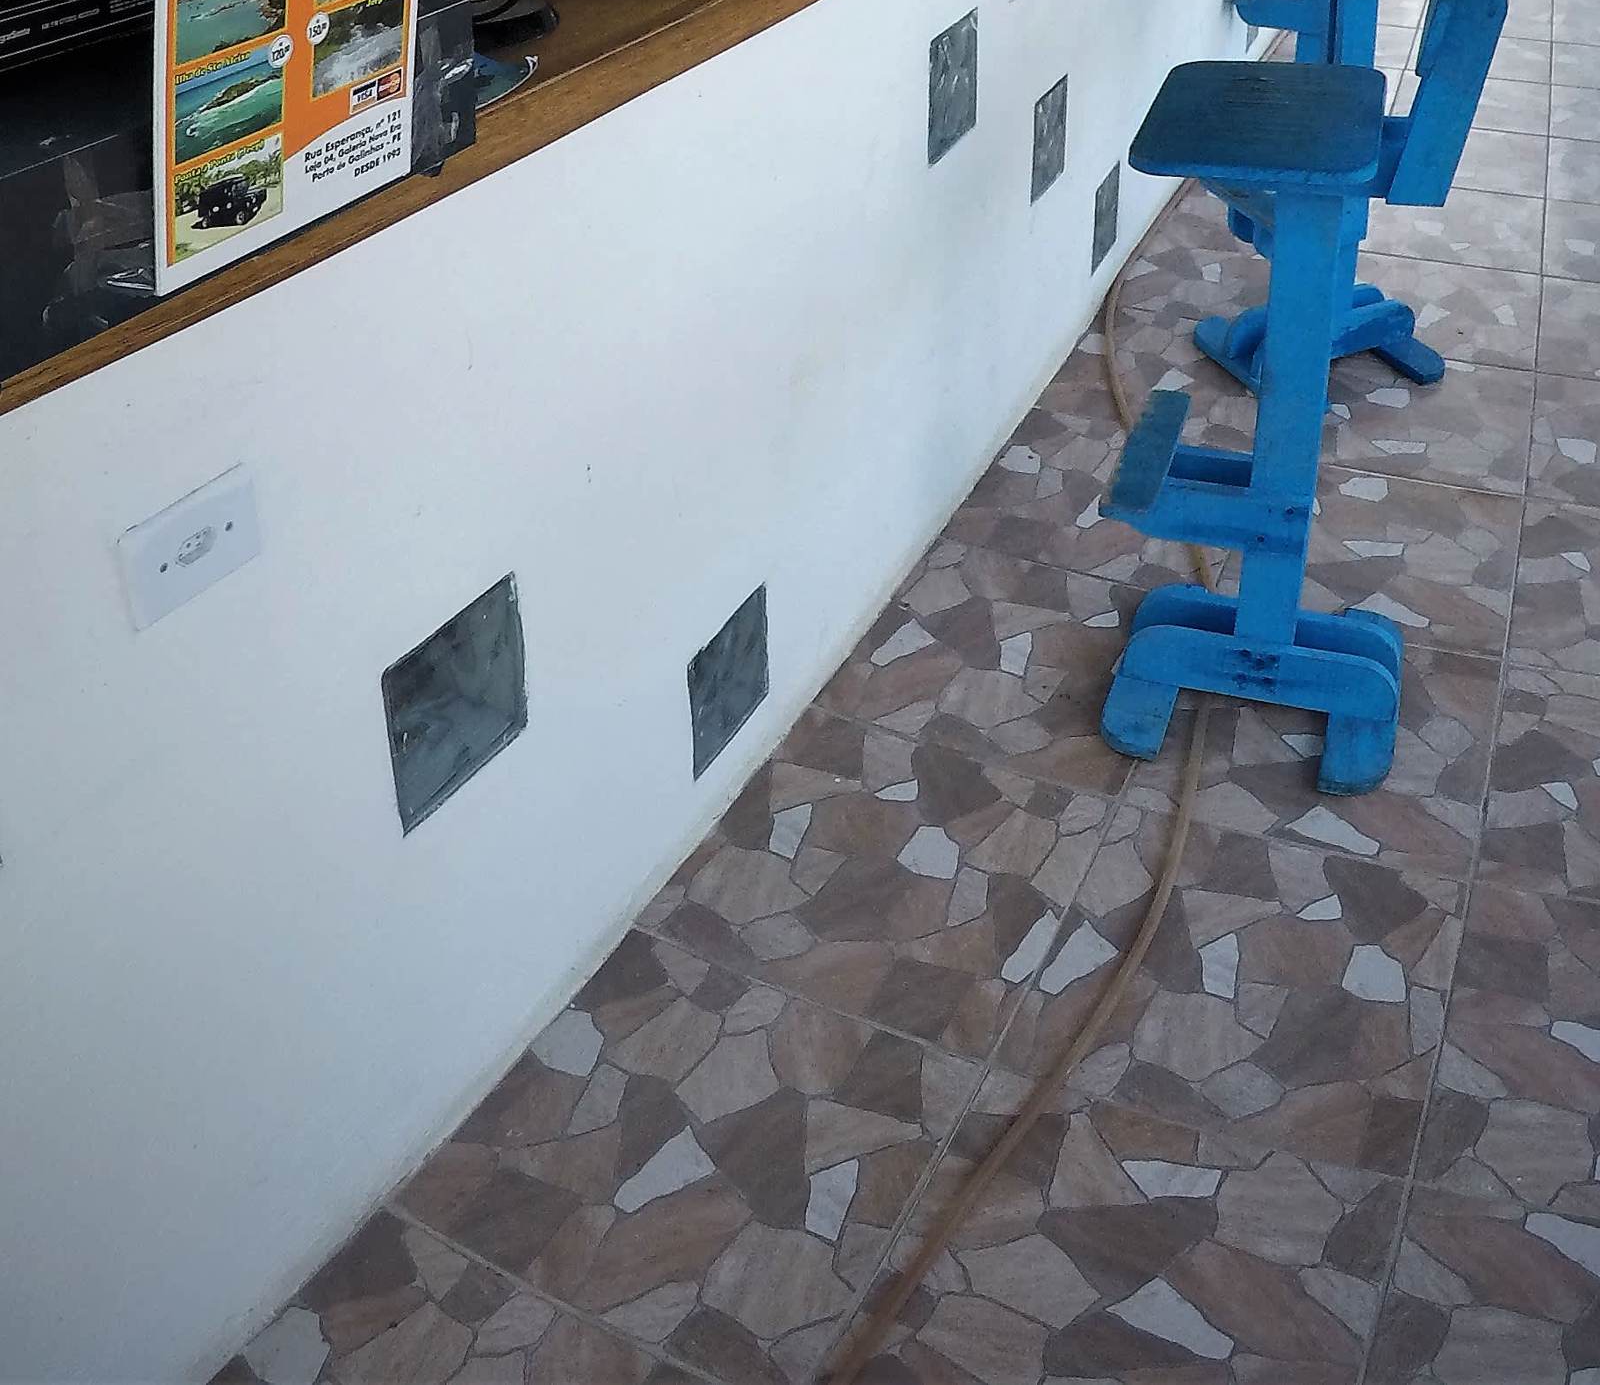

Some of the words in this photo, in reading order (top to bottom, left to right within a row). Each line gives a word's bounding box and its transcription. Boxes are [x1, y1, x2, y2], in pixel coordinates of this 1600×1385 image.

[304, 148, 323, 162] Rua
[326, 126, 373, 152] Esperança,
[387, 109, 401, 124] 121
[304, 160, 322, 174] Loja
[338, 140, 367, 158] Galeria
[369, 129, 388, 143] Nova
[312, 166, 335, 183] Porto
[348, 142, 384, 165] Galinhas
[354, 157, 380, 177] DESDE
